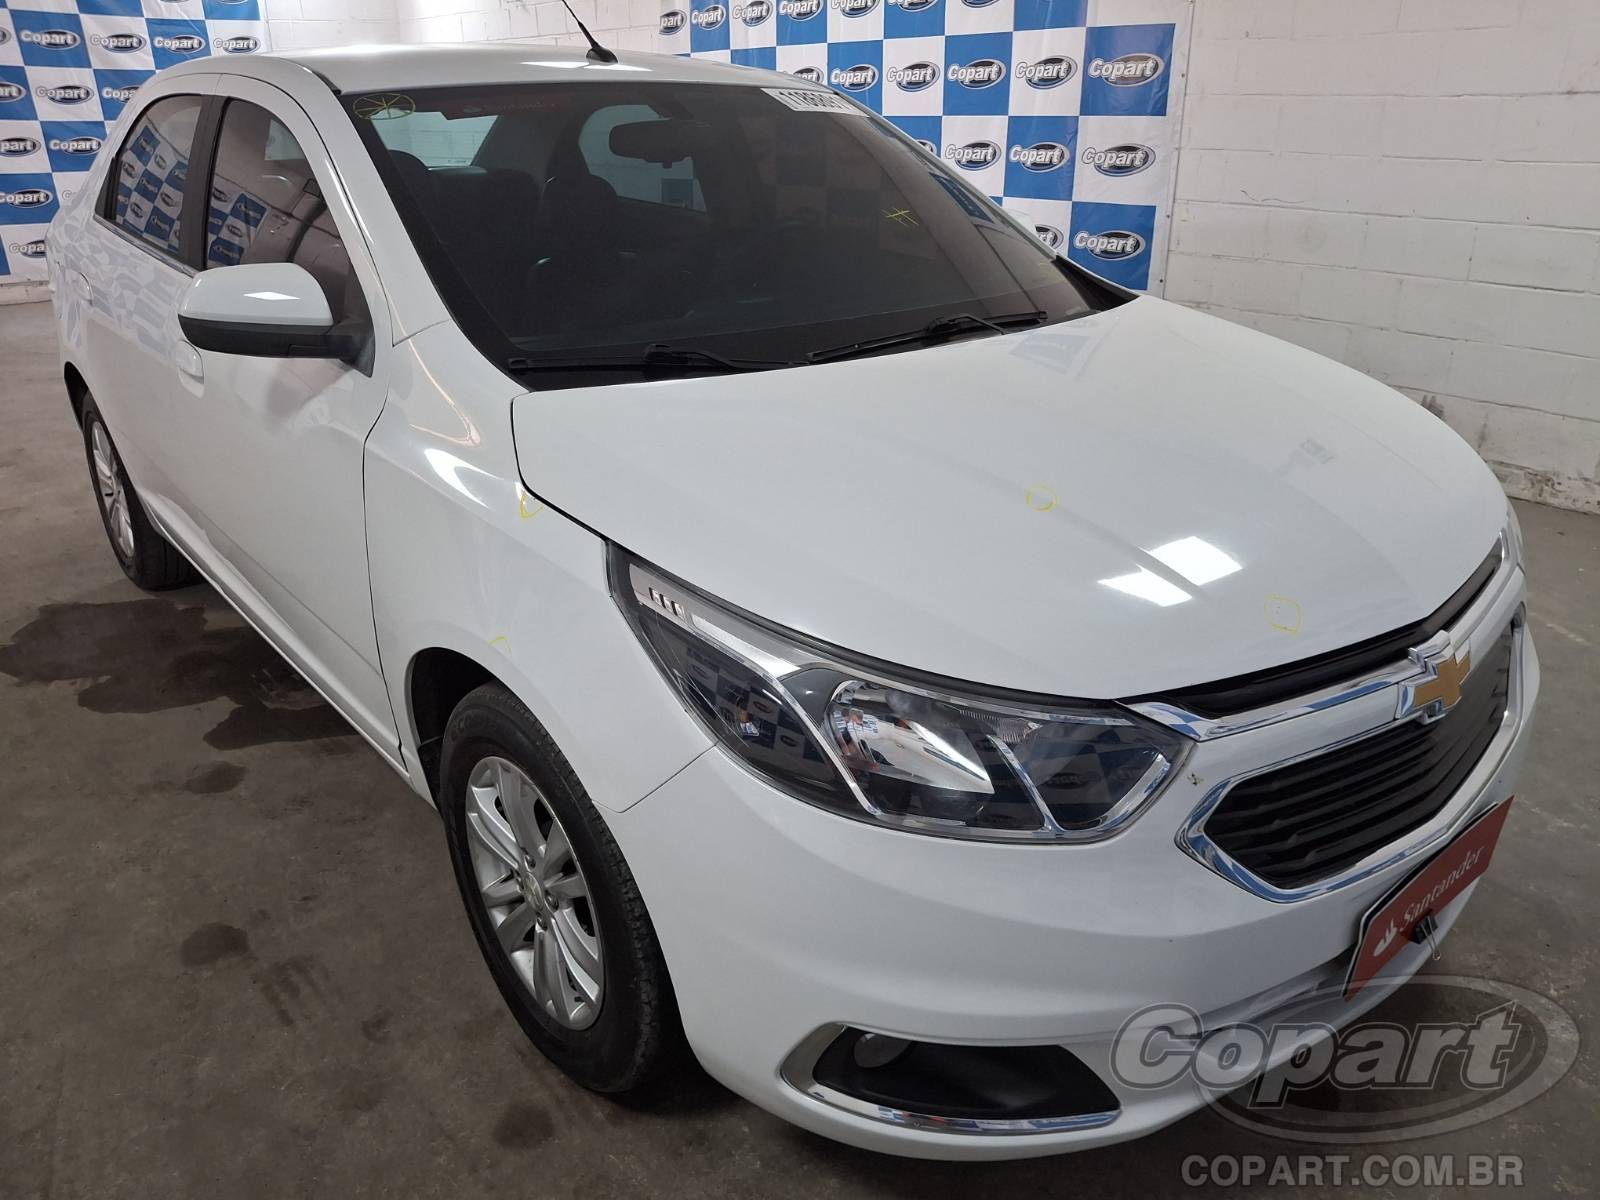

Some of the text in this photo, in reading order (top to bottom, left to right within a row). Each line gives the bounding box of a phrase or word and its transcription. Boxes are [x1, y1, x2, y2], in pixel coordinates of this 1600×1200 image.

[691, 8, 722, 26] Copart
[733, 3, 769, 24] Copart
[779, 0, 818, 16] Copart
[20, 30, 75, 46] Copart
[90, 34, 141, 48] Copart
[153, 37, 201, 51] Copart
[213, 38, 257, 51] Copart
[831, 68, 874, 88] Copart
[886, 66, 932, 87] Copart
[946, 63, 1000, 85] Copart
[1014, 59, 1070, 83] Copart
[1088, 55, 1157, 82] Copart
[36, 86, 88, 100] Copart
[50, 139, 99, 153] Copart
[945, 144, 994, 162] Copart
[1010, 144, 1064, 166] Copart
[1082, 147, 1146, 169] Copart
[1074, 230, 1139, 254] Copart
[1400, 846, 1484, 932] Santander
